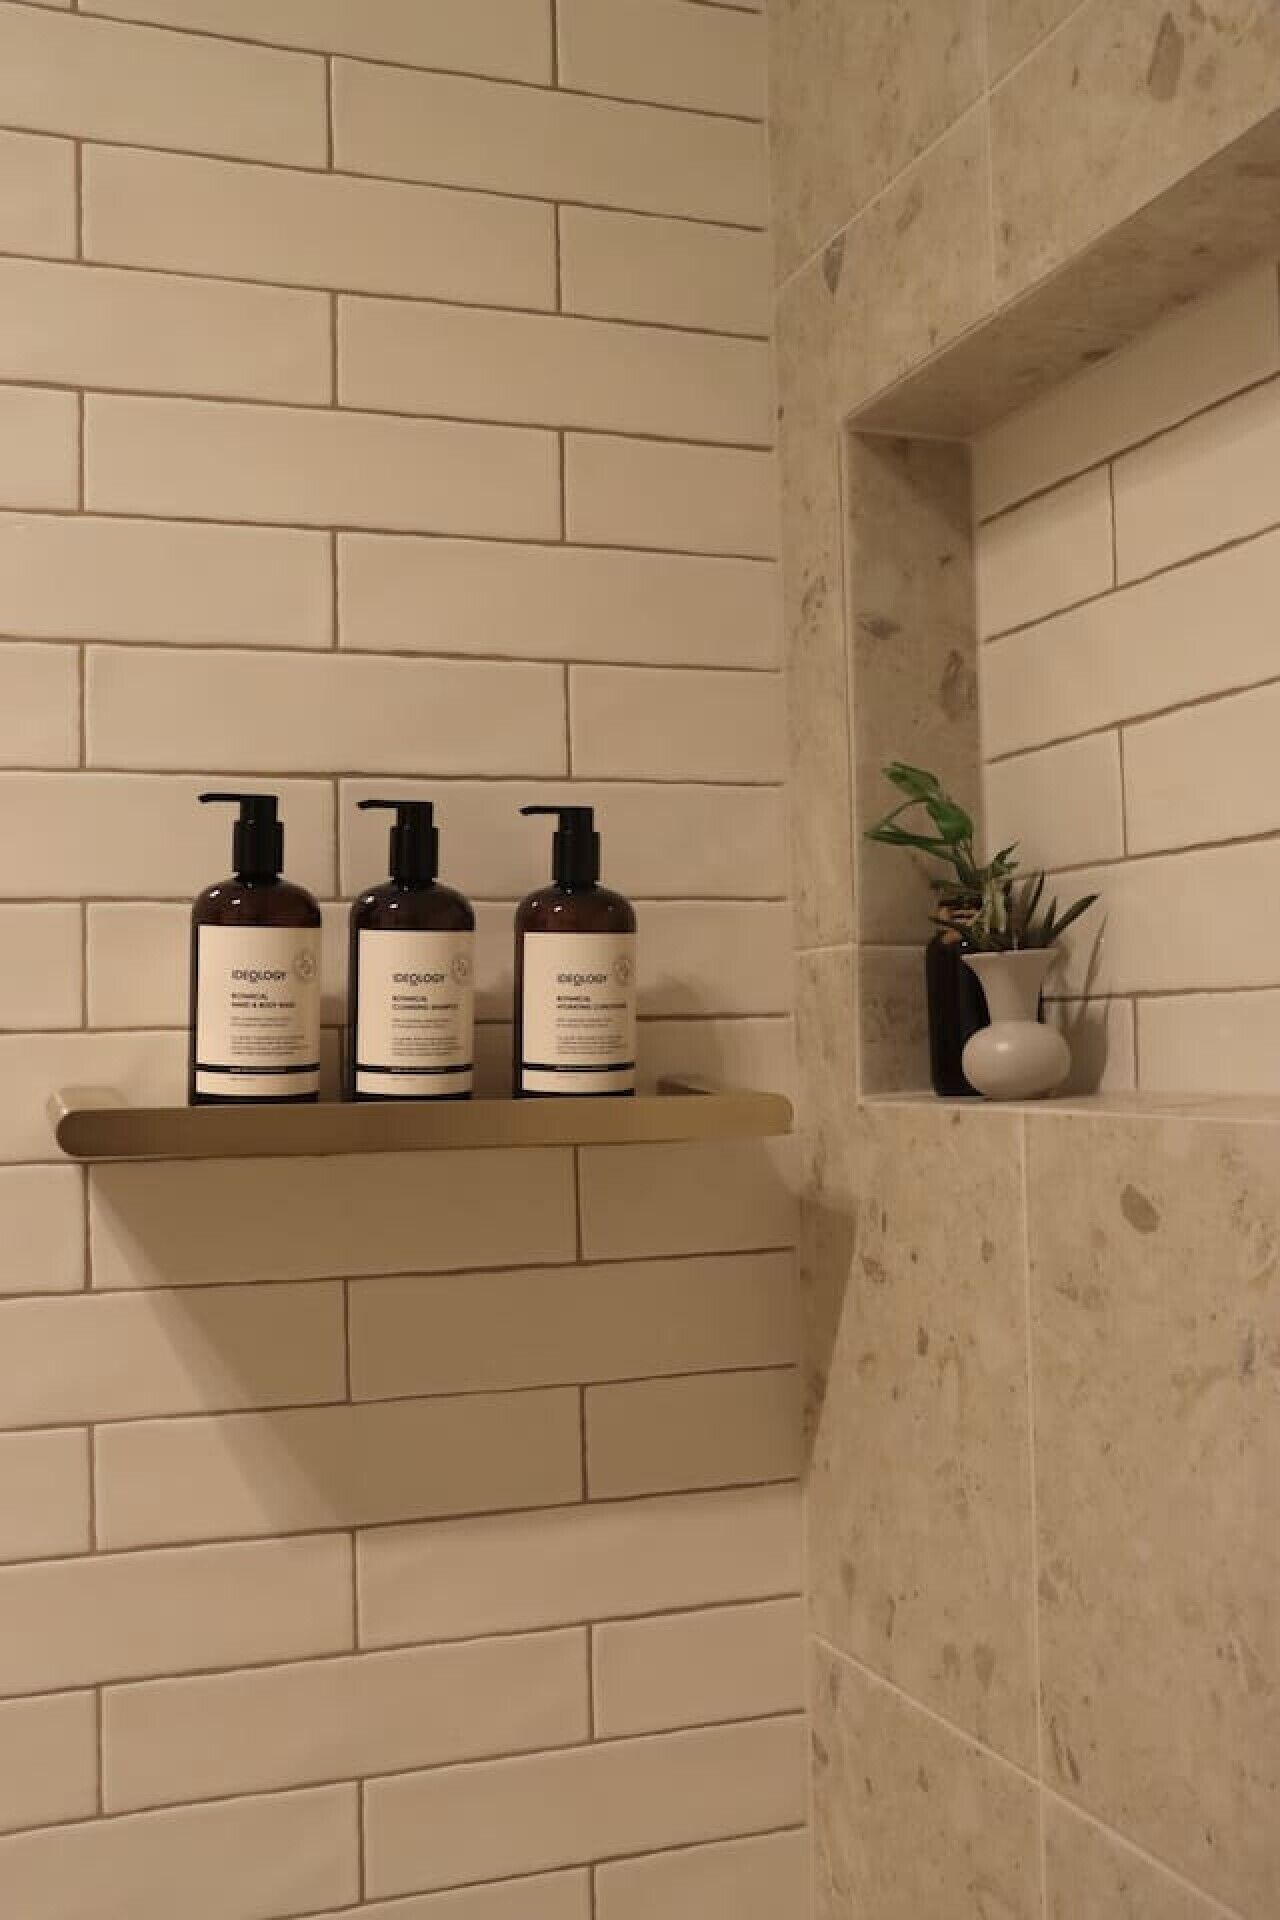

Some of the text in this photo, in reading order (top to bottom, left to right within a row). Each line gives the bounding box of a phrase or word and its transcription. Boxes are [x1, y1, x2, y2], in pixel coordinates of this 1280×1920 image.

[231, 969, 287, 983] IDEOLOGY
[393, 973, 446, 986] IDEOLOGY
[557, 973, 607, 986] IDEOLOGY
